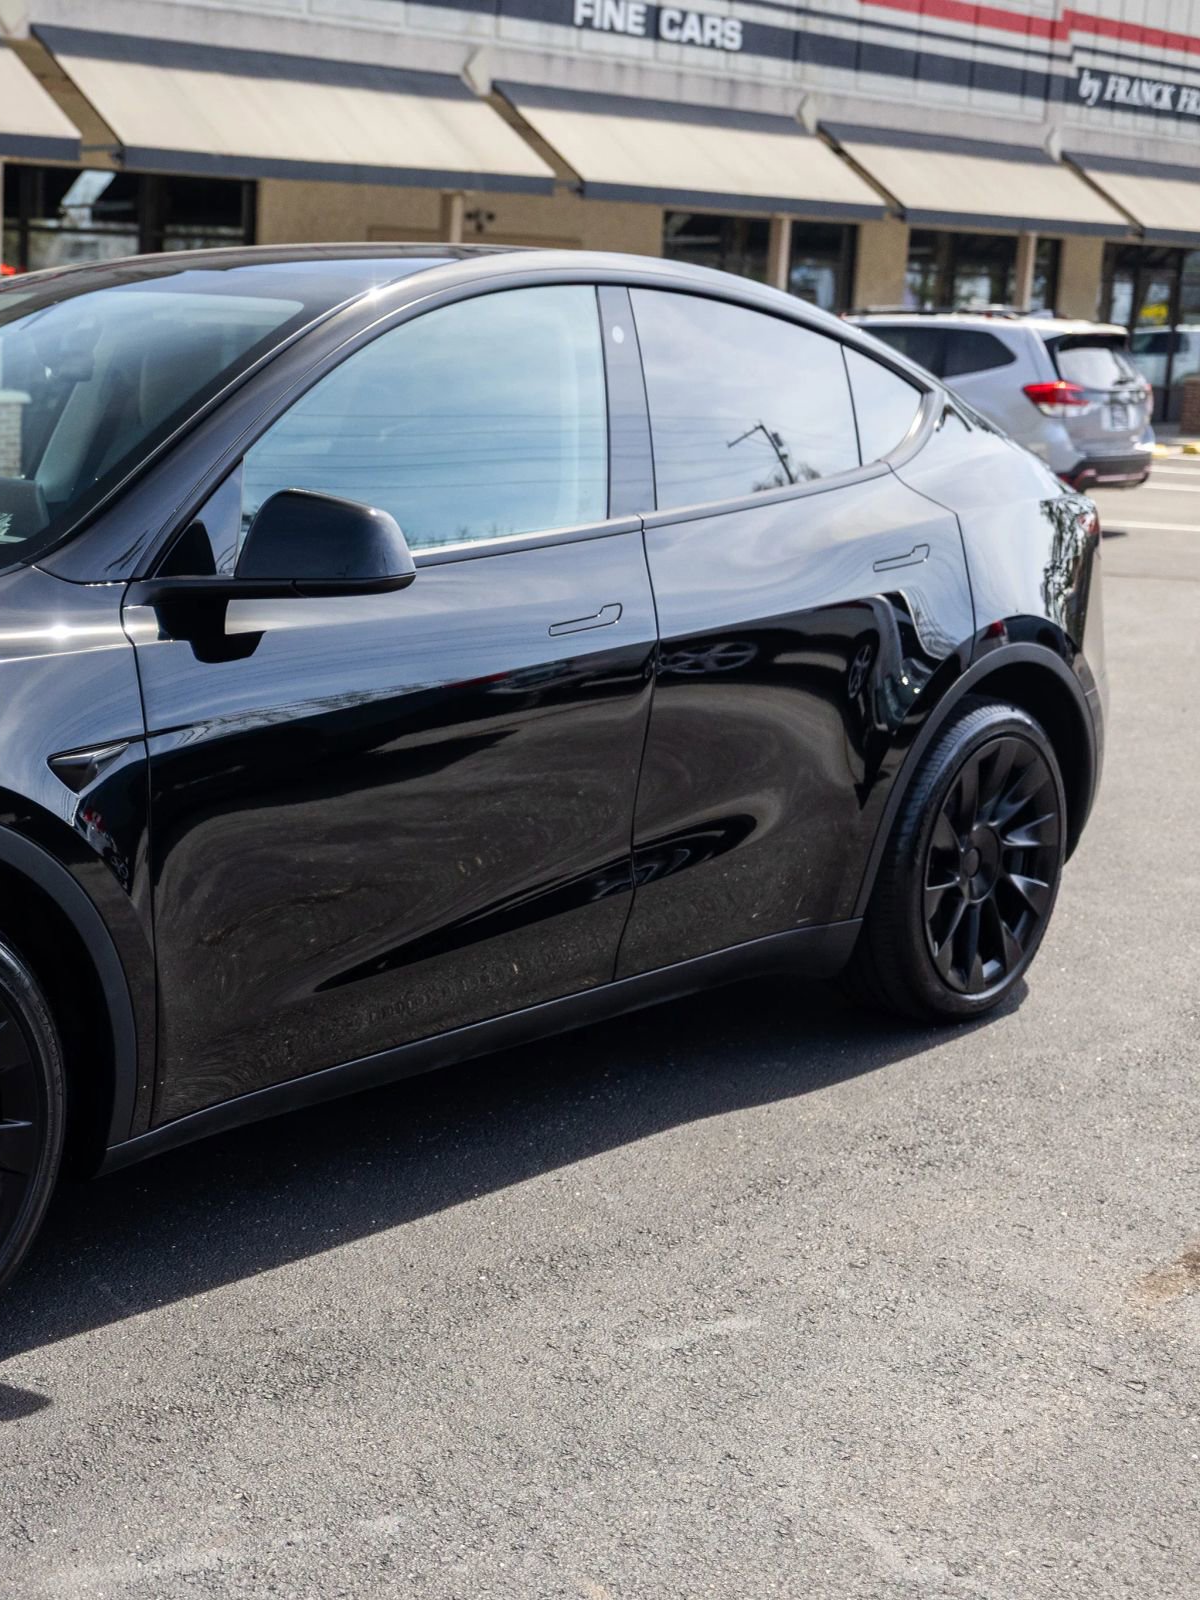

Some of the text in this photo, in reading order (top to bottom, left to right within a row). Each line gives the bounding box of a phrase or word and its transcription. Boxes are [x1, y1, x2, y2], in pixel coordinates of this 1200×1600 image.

[573, 0, 743, 51] FINE CARS
[1078, 69, 1102, 106] by
[1103, 74, 1176, 111] FRANCK
